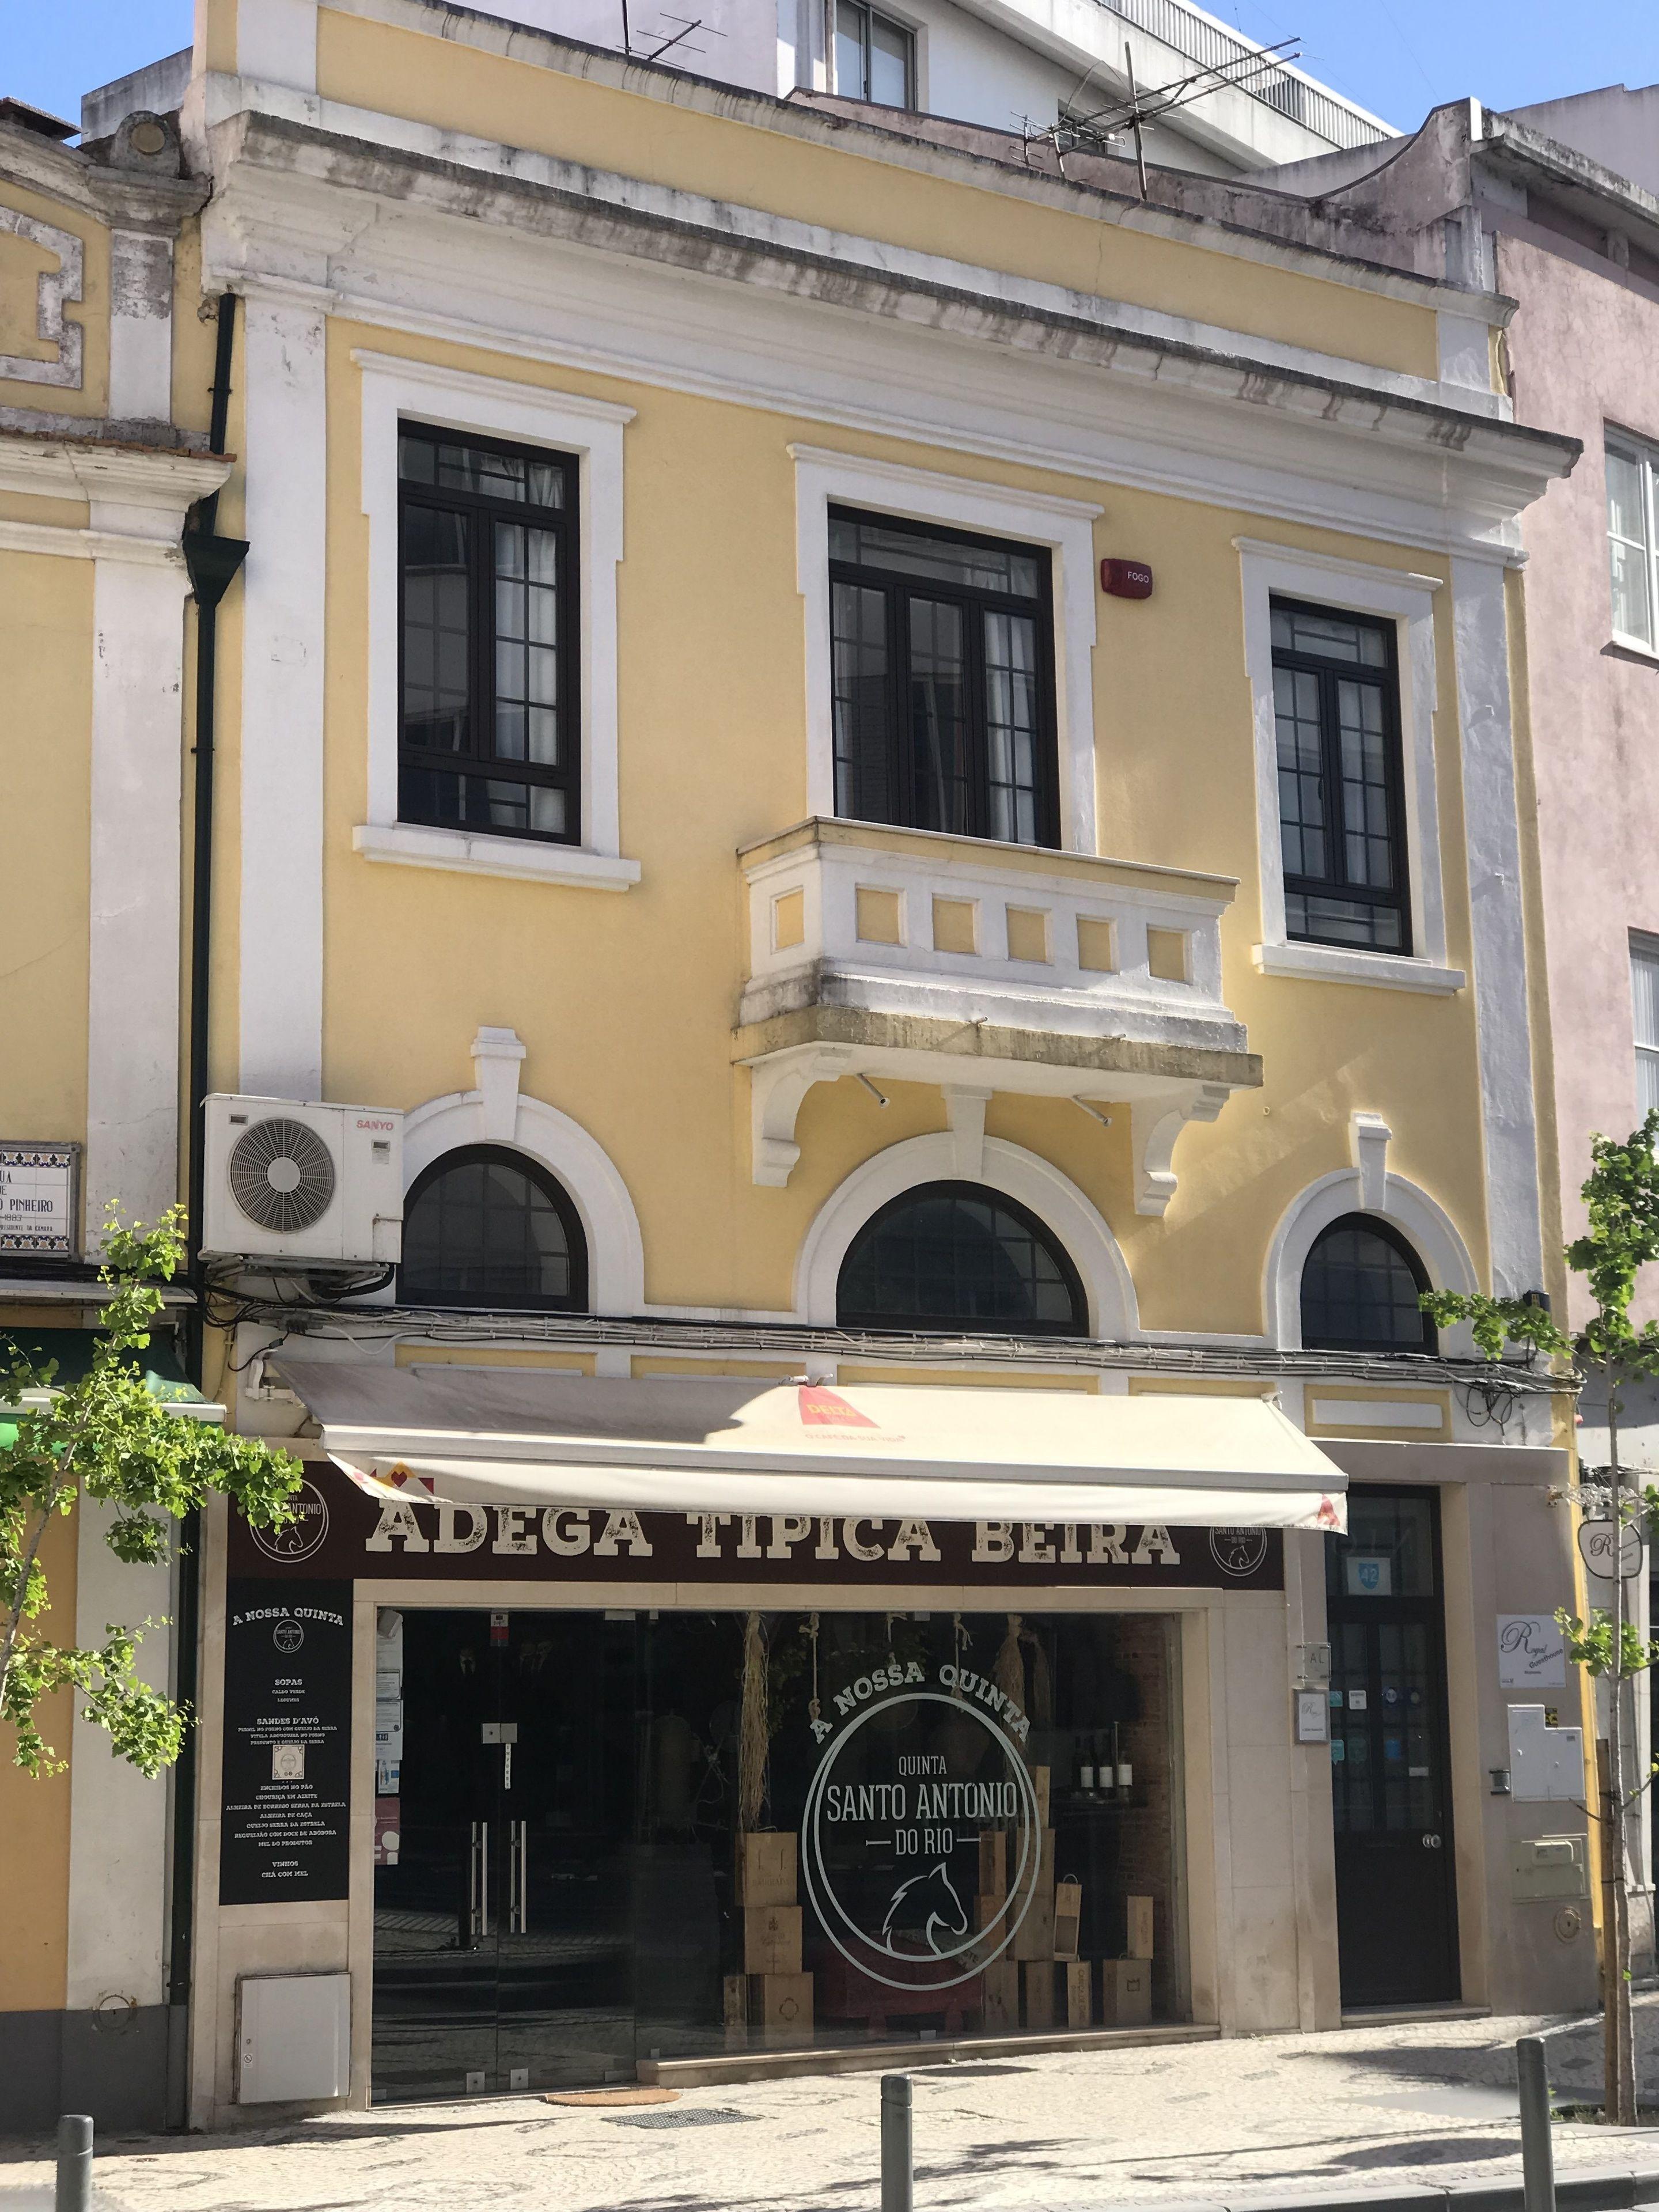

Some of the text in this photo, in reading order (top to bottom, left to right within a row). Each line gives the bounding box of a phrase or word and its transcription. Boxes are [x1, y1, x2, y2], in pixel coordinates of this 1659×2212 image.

[1127, 571, 1149, 583] FOGO
[357, 1120, 394, 1131] SANYO
[0, 1171, 12, 1183] UA
[10, 1199, 53, 1212] PINHEIRO
[806, 1404, 858, 1418] DELTA
[365, 1499, 653, 1556] ADEGA
[972, 1521, 1180, 1565] BEIRA
[1362, 1568, 1378, 1582] 42
[233, 1608, 343, 1626] A NOSSA QUINTA
[1529, 1649, 1563, 1668] Guesthouse
[810, 1661, 1031, 1744] A NOSSA QUINTA
[899, 1756, 948, 1777] QUINTA
[827, 1785, 906, 1822] SANTO
[896, 1827, 953, 1855] DO RIO
